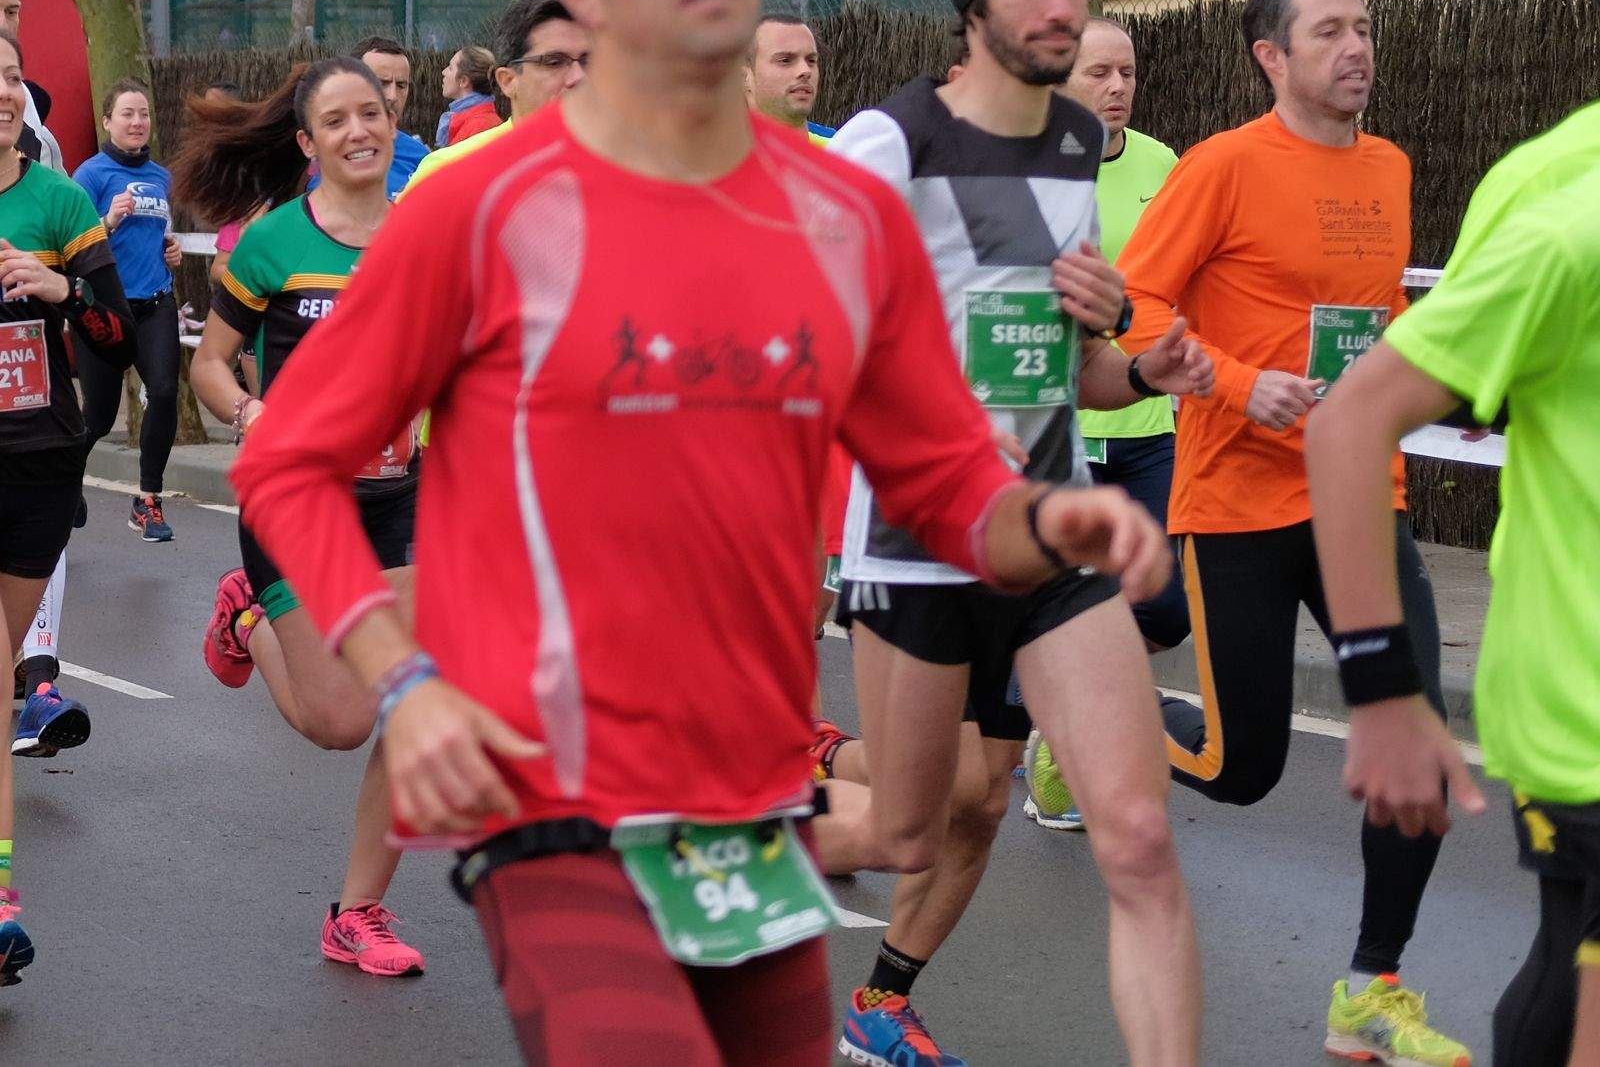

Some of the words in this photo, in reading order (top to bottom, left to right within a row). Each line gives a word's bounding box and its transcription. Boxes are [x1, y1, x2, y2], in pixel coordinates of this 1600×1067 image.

[1316, 206, 1366, 216] GARMIN
[1318, 217, 1344, 230] Sant
[1347, 217, 1392, 230] Silvestre
[991, 323, 1064, 344] SERGIO
[1013, 348, 1048, 376] 23
[693, 872, 760, 924] 94
